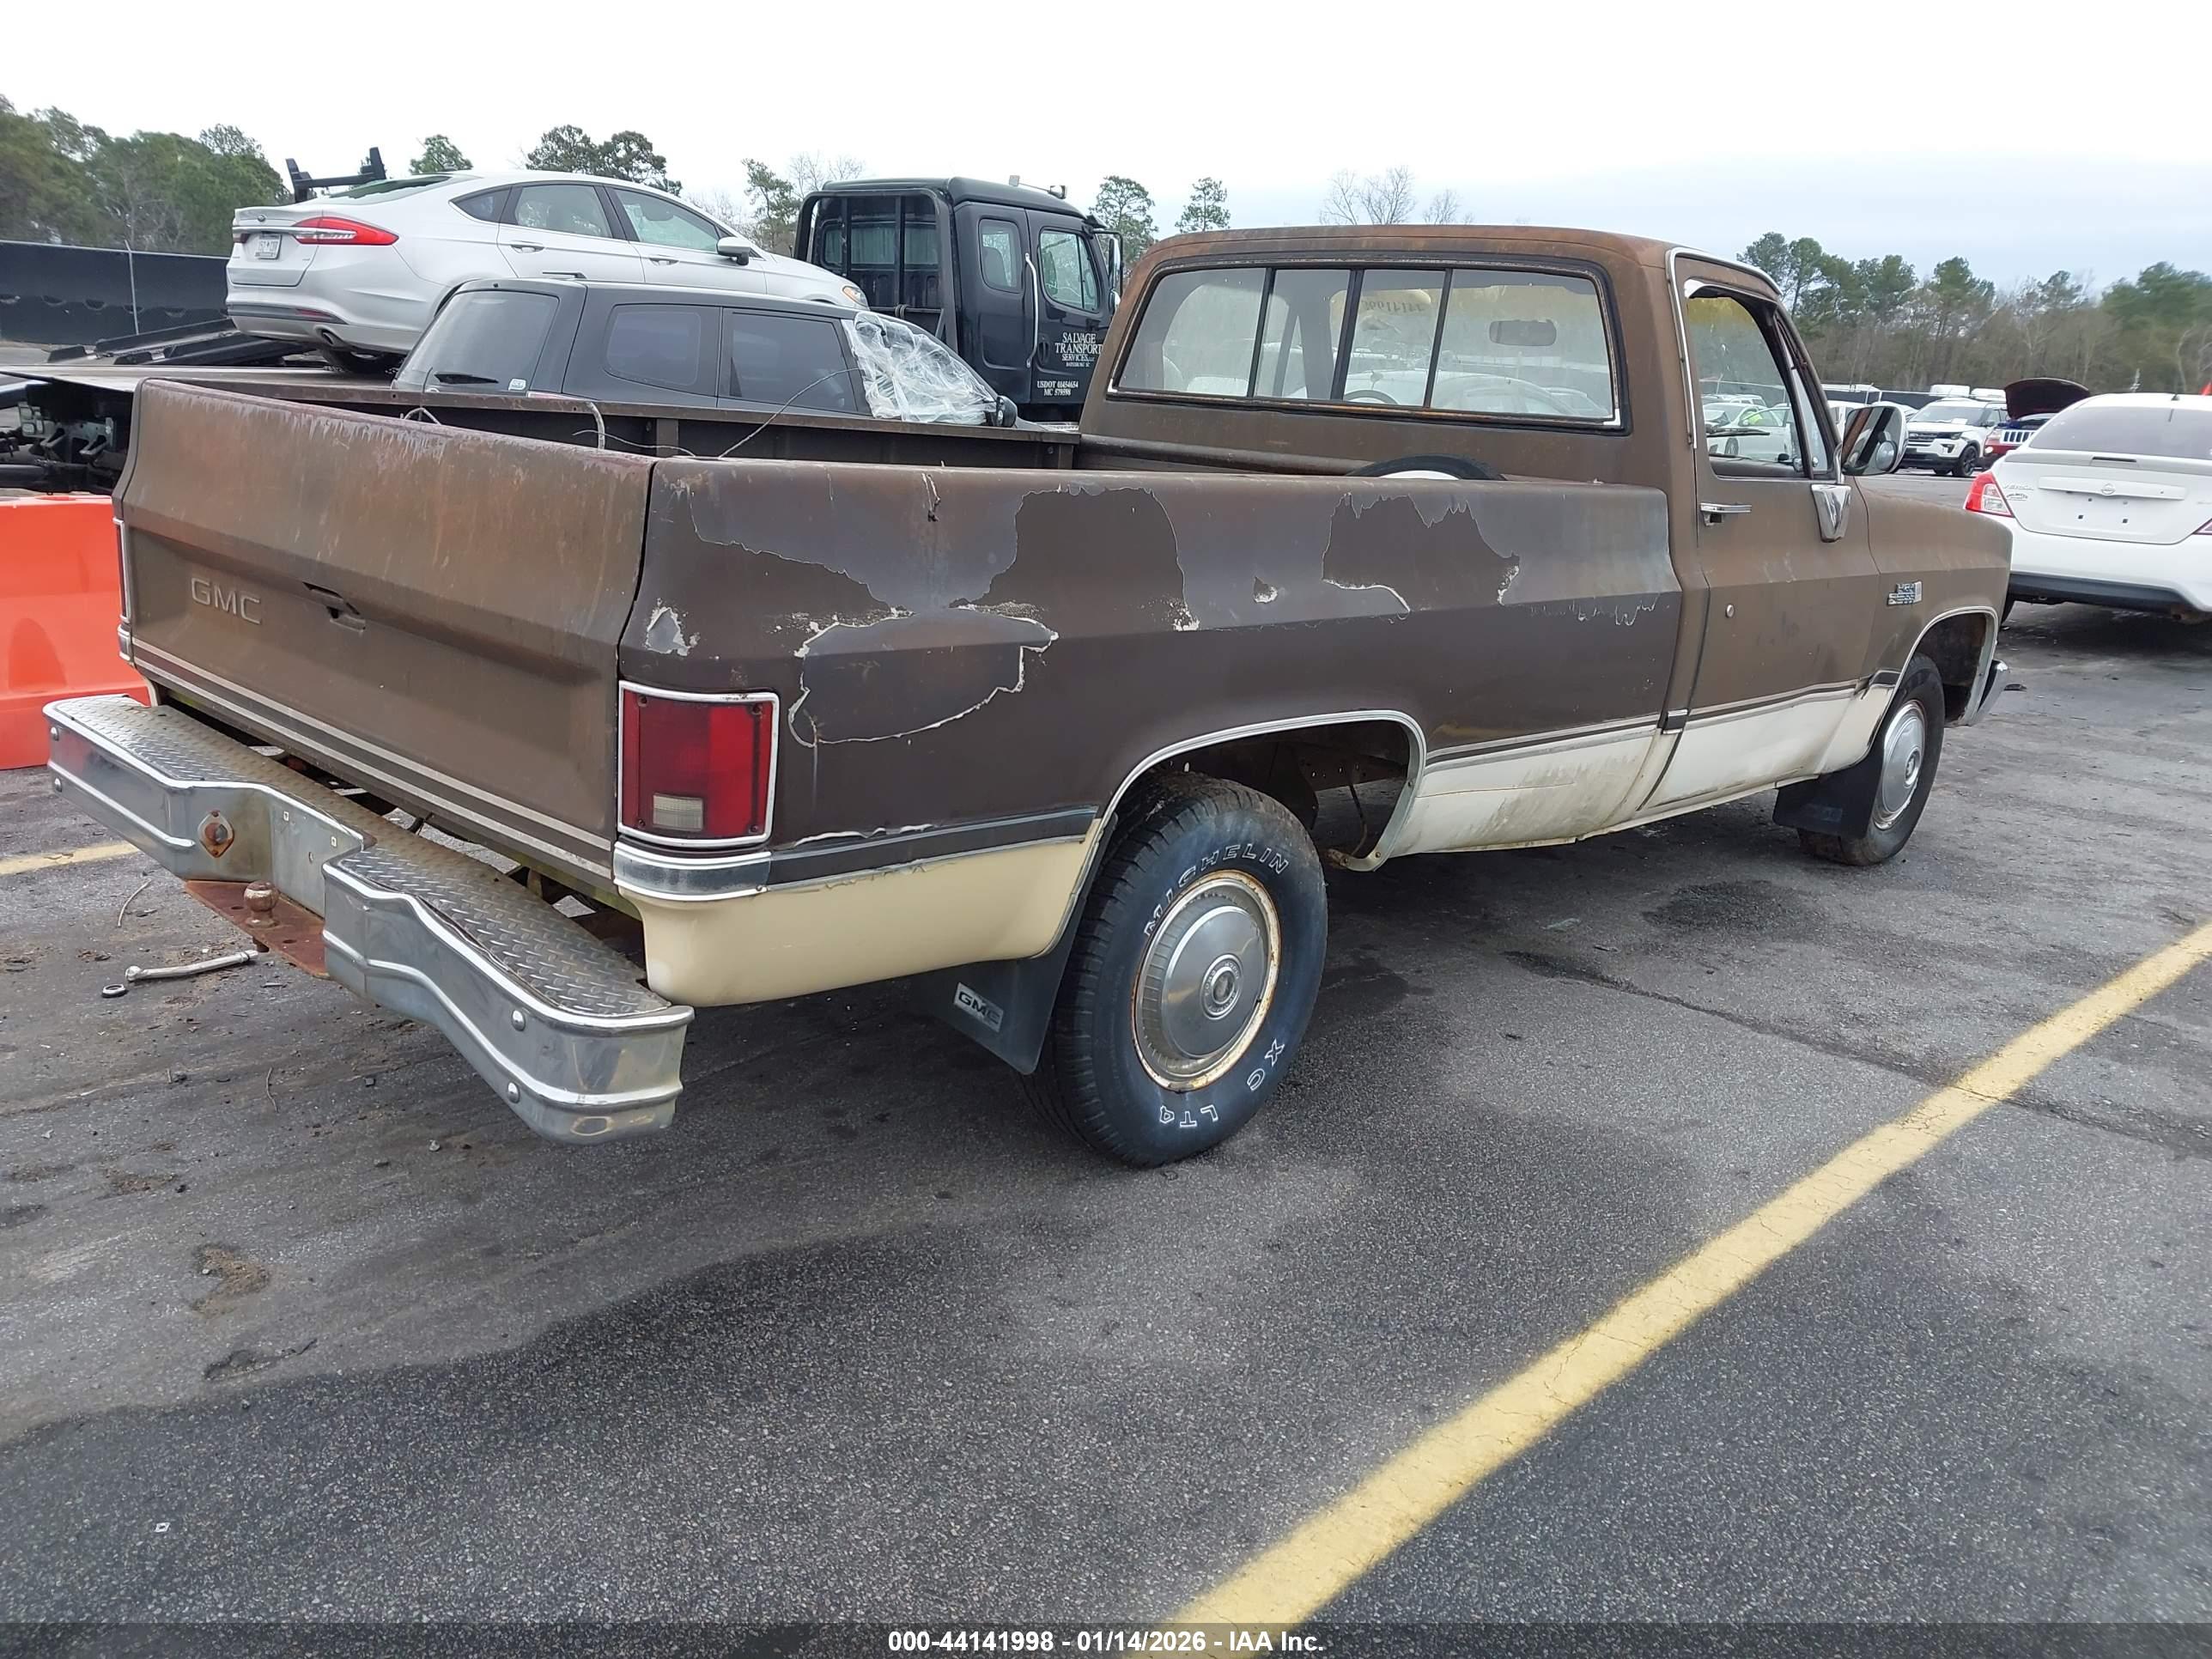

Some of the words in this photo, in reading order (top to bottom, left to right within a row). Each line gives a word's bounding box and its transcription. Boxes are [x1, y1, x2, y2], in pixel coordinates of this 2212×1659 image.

[1054, 343, 1104, 354] TRANSPORT
[1062, 332, 1097, 343] SALVAGE
[191, 578, 261, 625] GMC
[1144, 843, 1289, 937] MICHELIN
[958, 991, 1000, 1024] GMC
